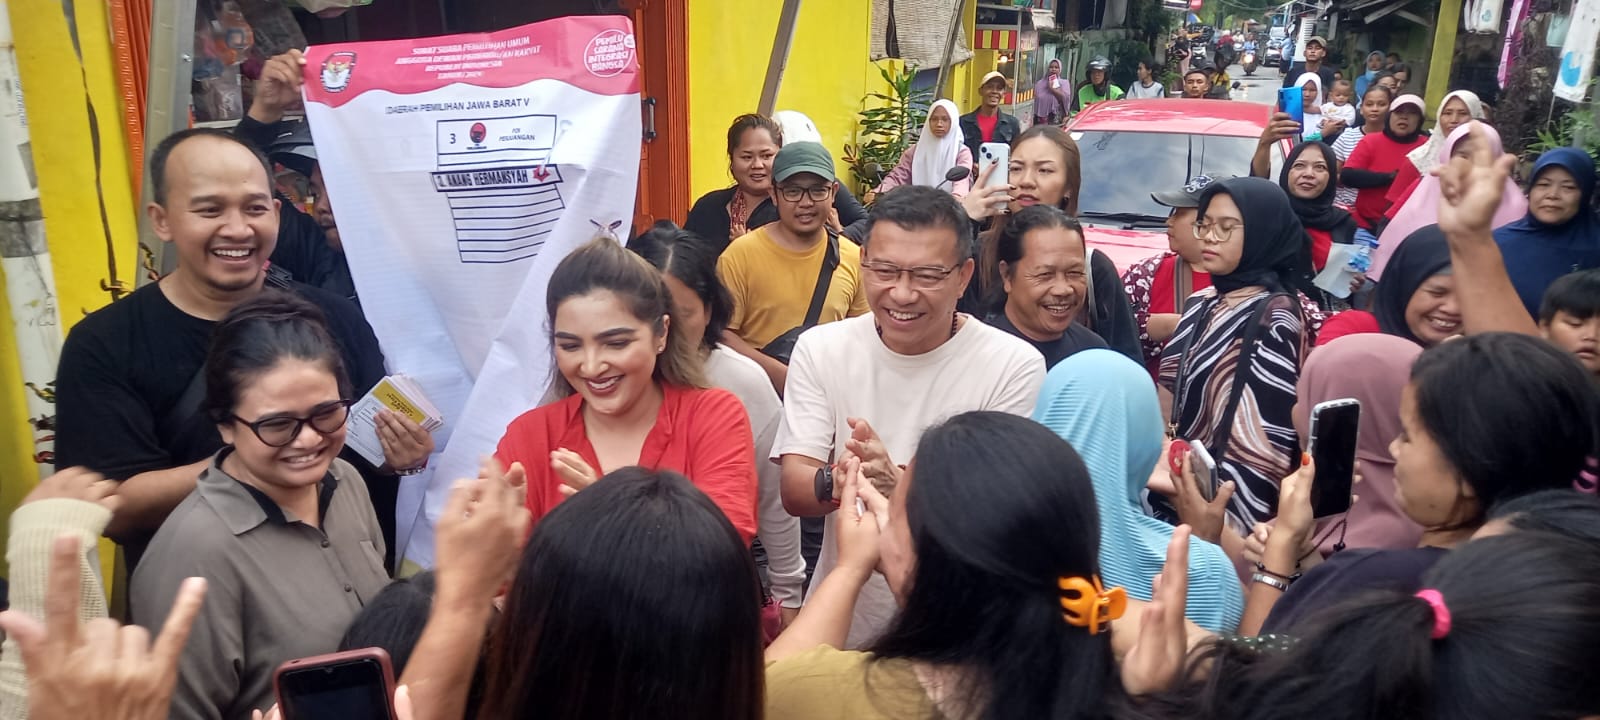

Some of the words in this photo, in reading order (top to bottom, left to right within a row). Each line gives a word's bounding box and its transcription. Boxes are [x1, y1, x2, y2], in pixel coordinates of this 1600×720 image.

[507, 36, 530, 46] UMUM
[385, 104, 418, 114] DAERAH
[420, 102, 464, 112] PEMILIHAN
[466, 101, 491, 110] JAWA
[493, 98, 522, 108] BARAT
[523, 97, 530, 106] V
[449, 133, 456, 144] 3
[446, 172, 473, 187] ANANG
[472, 169, 529, 186] HERMANSYAH
